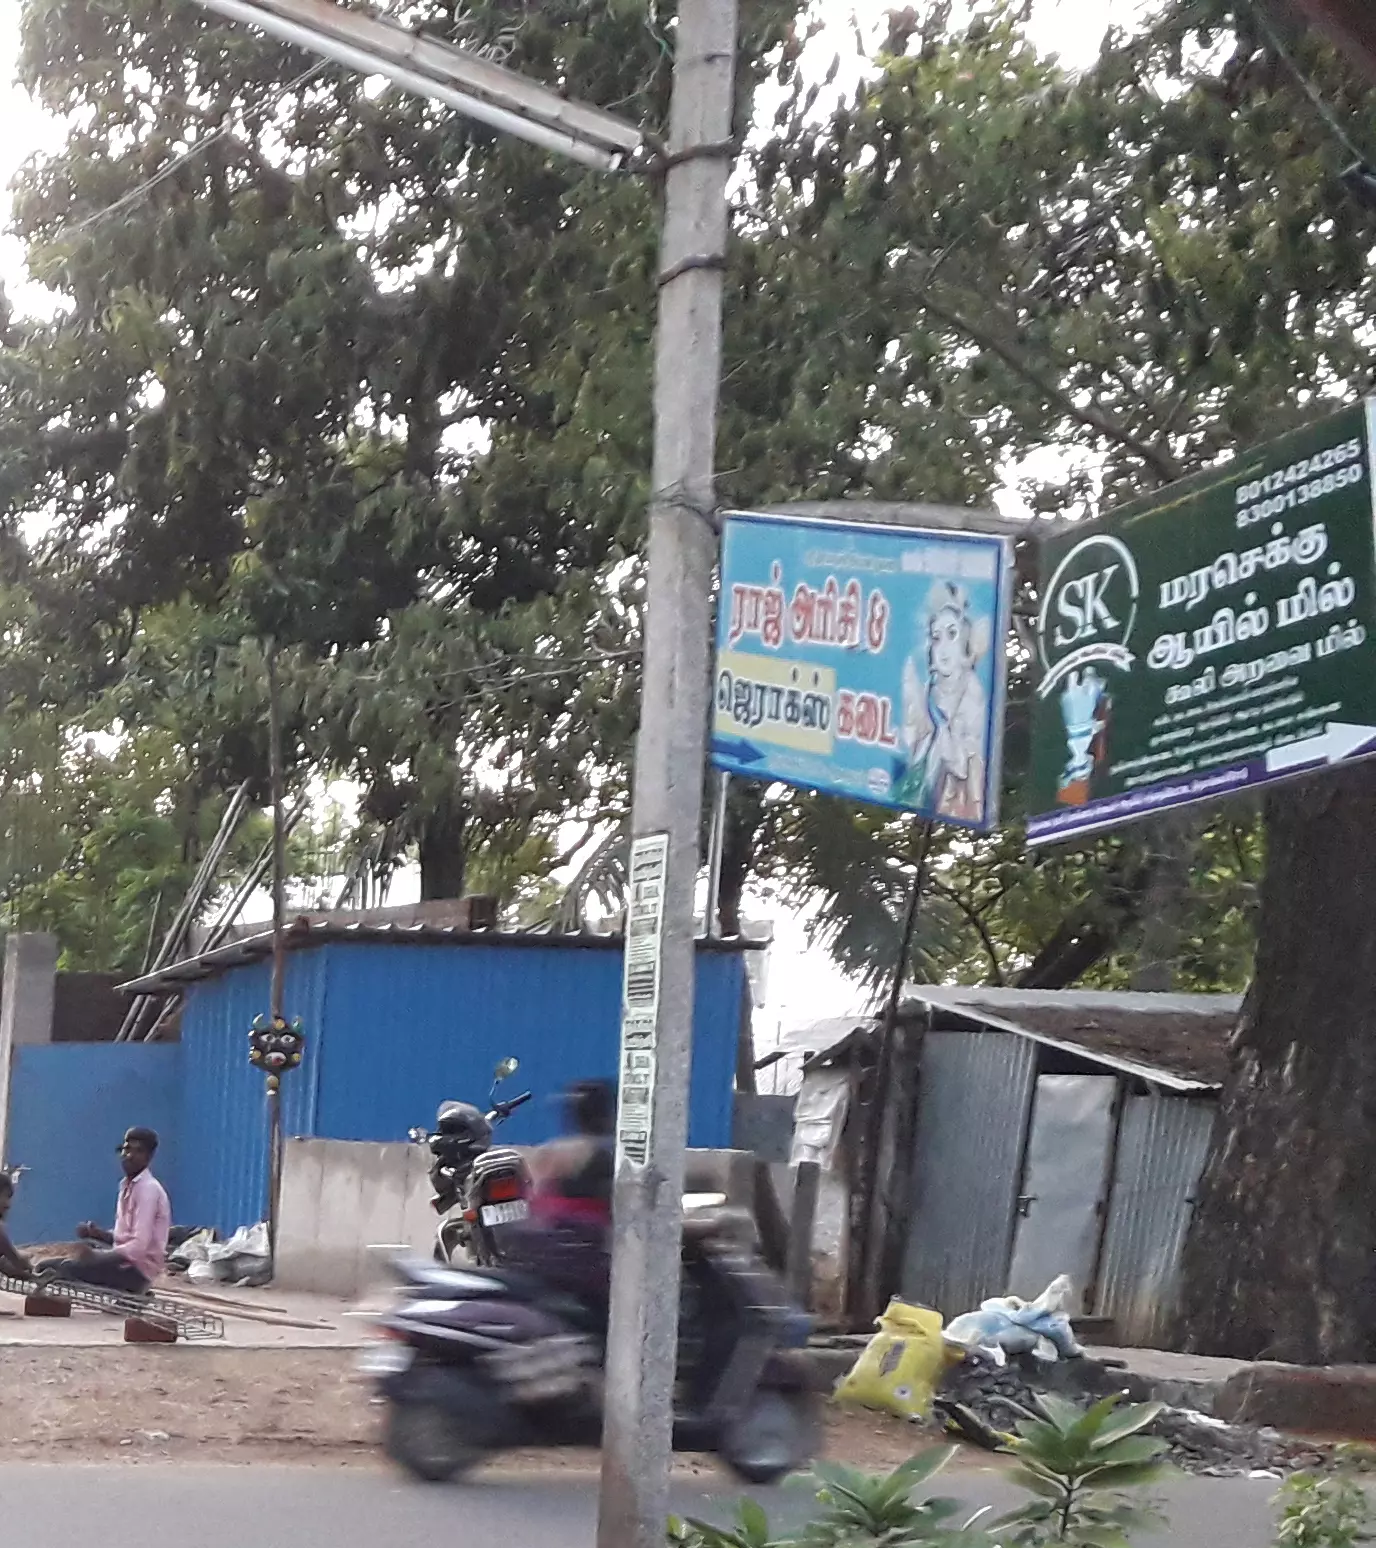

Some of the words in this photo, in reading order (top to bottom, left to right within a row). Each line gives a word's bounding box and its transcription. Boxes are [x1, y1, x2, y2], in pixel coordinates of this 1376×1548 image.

[727, 559, 785, 650] ராஜ்
[791, 575, 862, 648] அரிசி
[1054, 564, 1122, 647] SK
[1159, 522, 1328, 611] மரசெக்கு
[1147, 591, 1270, 669] ஆயில்
[1276, 561, 1356, 628] மில்
[1165, 665, 1217, 704] கூலி
[1218, 642, 1312, 687] அறவை
[1314, 618, 1367, 658] மில்
[715, 666, 832, 732] ஜெராக்ஸ்
[836, 689, 899, 746] கடை
